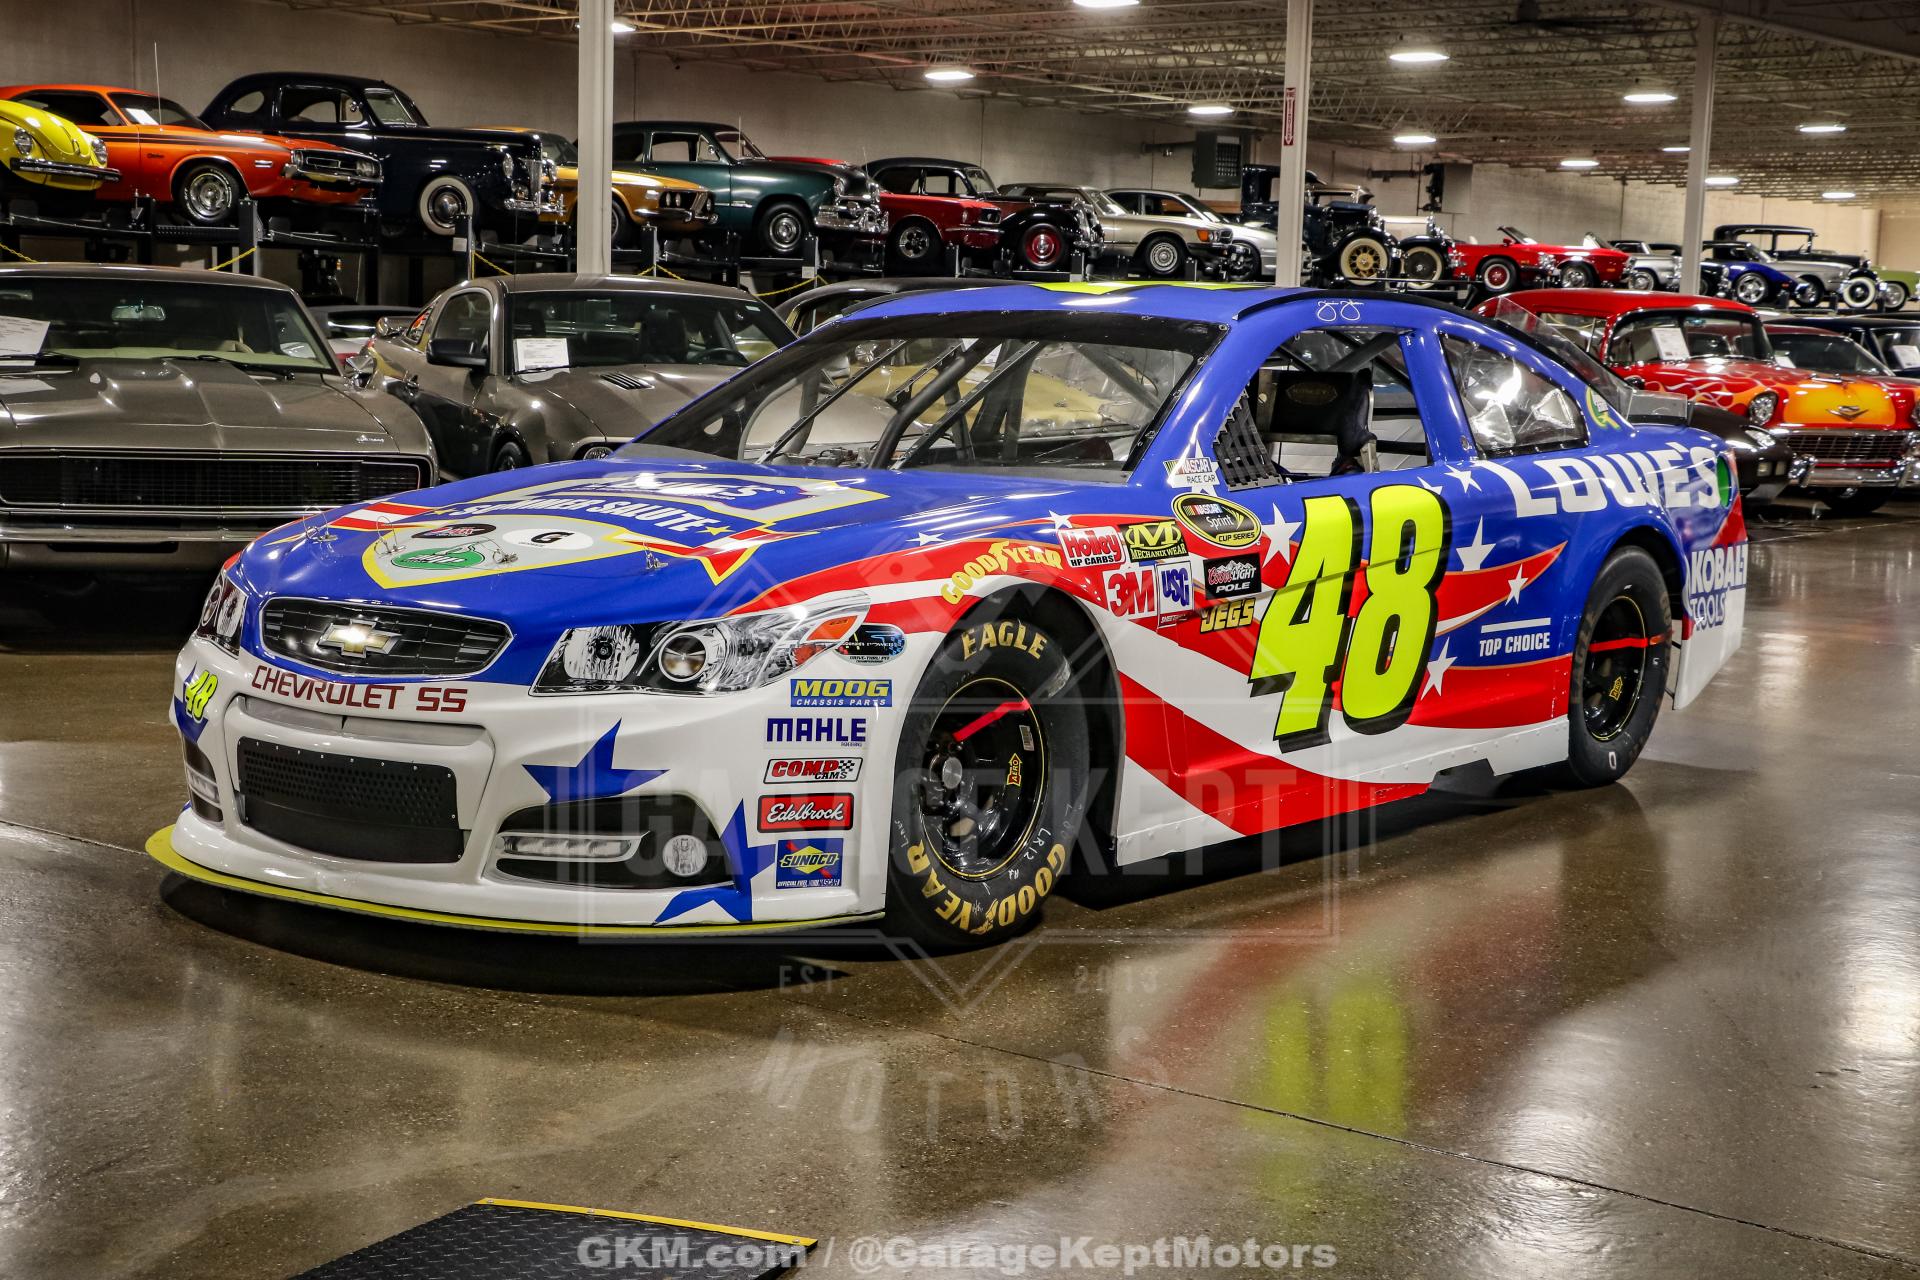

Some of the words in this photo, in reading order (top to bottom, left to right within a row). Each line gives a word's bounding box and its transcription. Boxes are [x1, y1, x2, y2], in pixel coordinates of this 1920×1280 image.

[1183, 459, 1212, 473] NASCAR
[1473, 442, 1721, 518] LOWE'S
[586, 502, 721, 532] SALUTE
[1196, 503, 1223, 514] NASCAR
[1206, 514, 1234, 530] Sprint
[1063, 530, 1121, 562] Holley
[1218, 534, 1232, 542] CUP
[1071, 558, 1082, 566] HP
[1085, 555, 1114, 565] CARBS
[1130, 549, 1166, 560] MECHANIX
[1167, 543, 1187, 557] WEAR
[941, 541, 1063, 605] GOODYEAR
[1208, 567, 1232, 585] Coors
[1232, 567, 1256, 580] LIGHT
[1691, 544, 1748, 593] KOBALT
[1108, 570, 1154, 617] 3M
[1161, 568, 1189, 606] USG
[1216, 581, 1251, 593] POLE
[1201, 597, 1255, 633] JEG'S
[1248, 484, 1449, 745] 48
[1690, 590, 1726, 631] TOOLS
[962, 621, 1047, 660] EAGLE
[1480, 638, 1502, 657] TOP
[1505, 632, 1550, 654] CHOICE
[184, 669, 218, 721] 48
[251, 665, 405, 710] CHEVROLET
[416, 686, 469, 713] SS
[793, 681, 889, 697] MOOG
[766, 718, 866, 742] MAHLE
[771, 760, 839, 777] COMP
[814, 771, 848, 780] CAMS
[767, 802, 844, 823] Edelbrock
[782, 854, 837, 867] SUNOCO
[907, 840, 1066, 934] GOODYEAR
